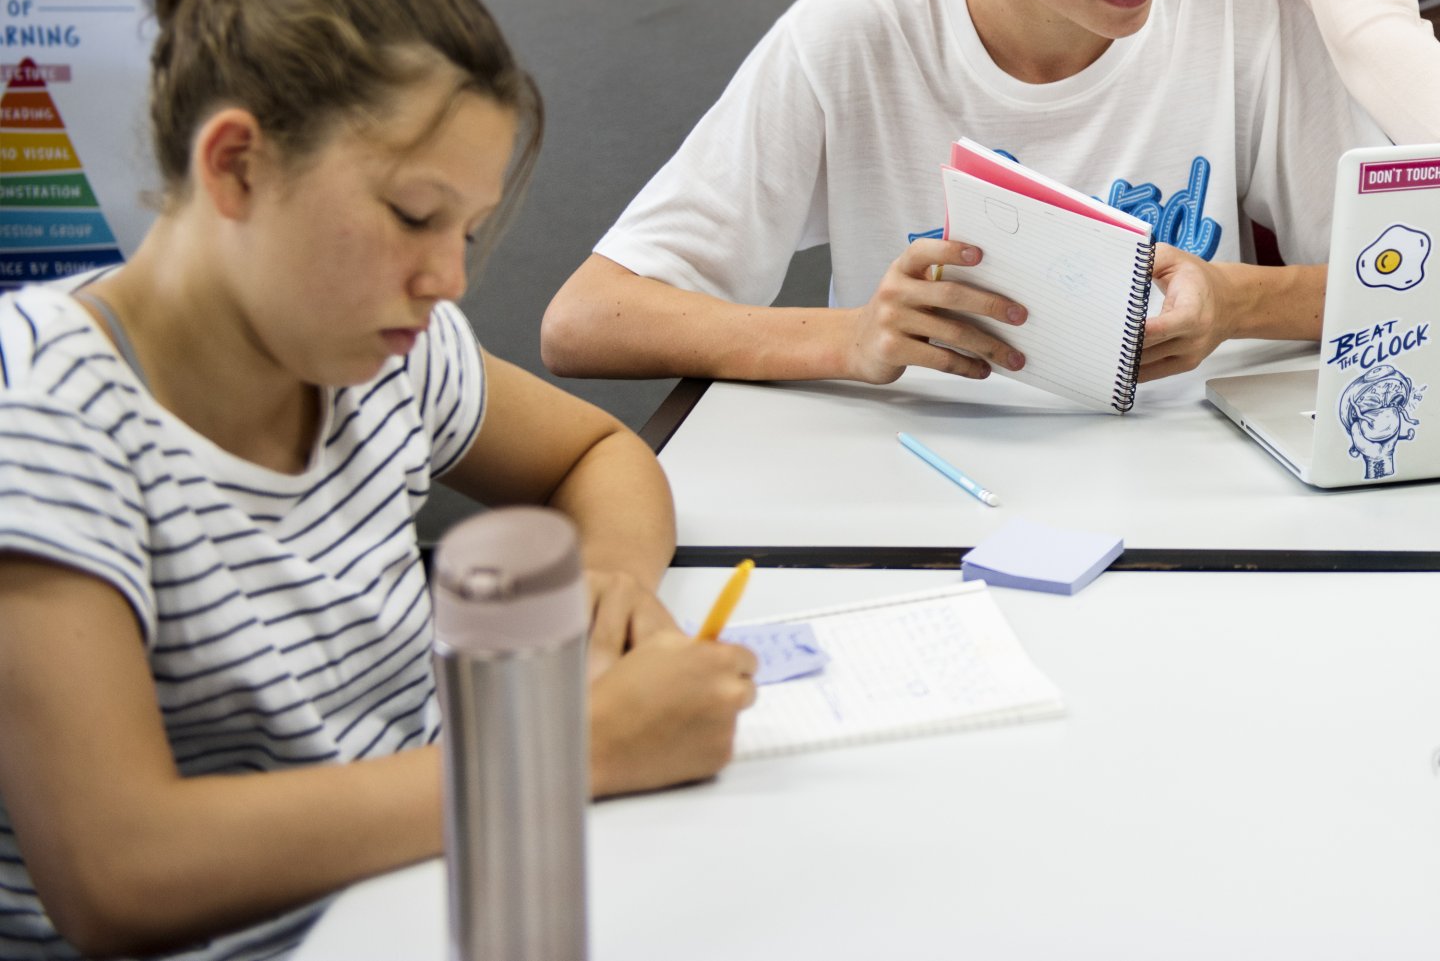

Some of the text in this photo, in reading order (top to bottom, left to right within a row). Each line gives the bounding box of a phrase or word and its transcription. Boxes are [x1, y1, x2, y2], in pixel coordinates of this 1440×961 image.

[0, 25, 80, 48] RNING
[23, 149, 70, 161] VISUAL
[1369, 168, 1402, 184] DON'T
[29, 263, 48, 275] BY
[1327, 320, 1398, 364] BEAT
[1337, 324, 1429, 370] THE CLOCK
